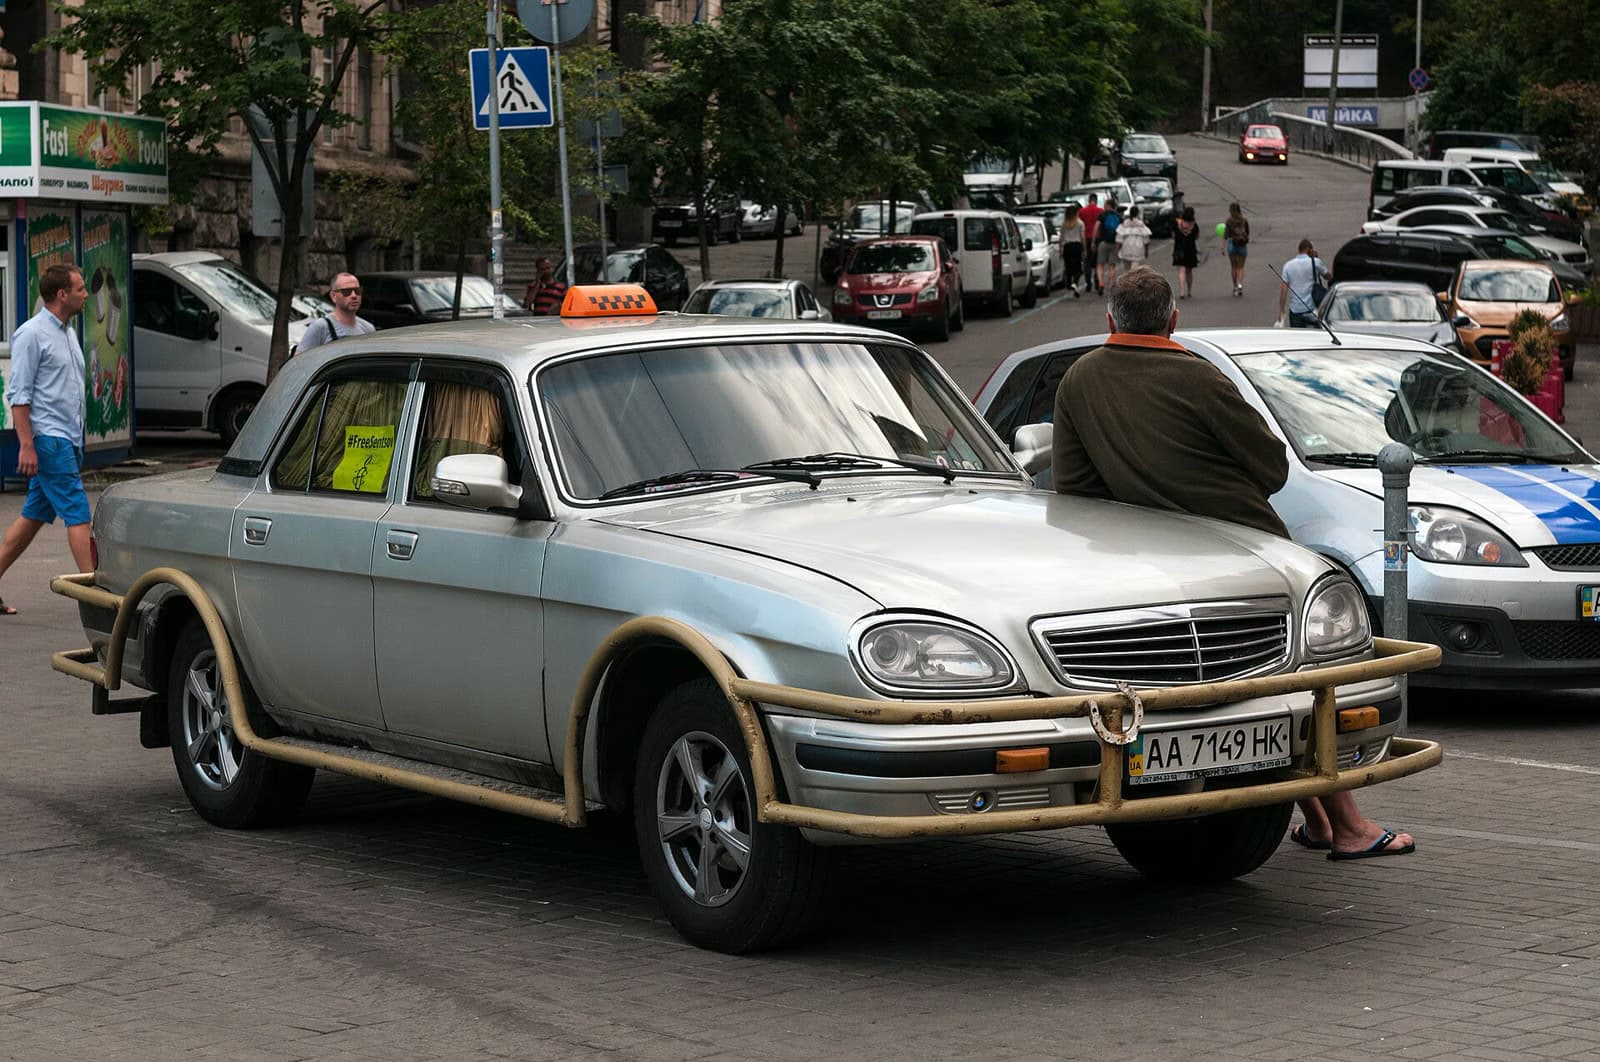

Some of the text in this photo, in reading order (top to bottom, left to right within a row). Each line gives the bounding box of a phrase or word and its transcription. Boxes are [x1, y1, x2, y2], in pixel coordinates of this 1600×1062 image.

[43, 119, 69, 156] Fast
[138, 131, 165, 165] Food
[92, 175, 124, 196] Шаурма
[1146, 723, 1284, 769] AA 7149 HK
[1130, 761, 1141, 771] UA
